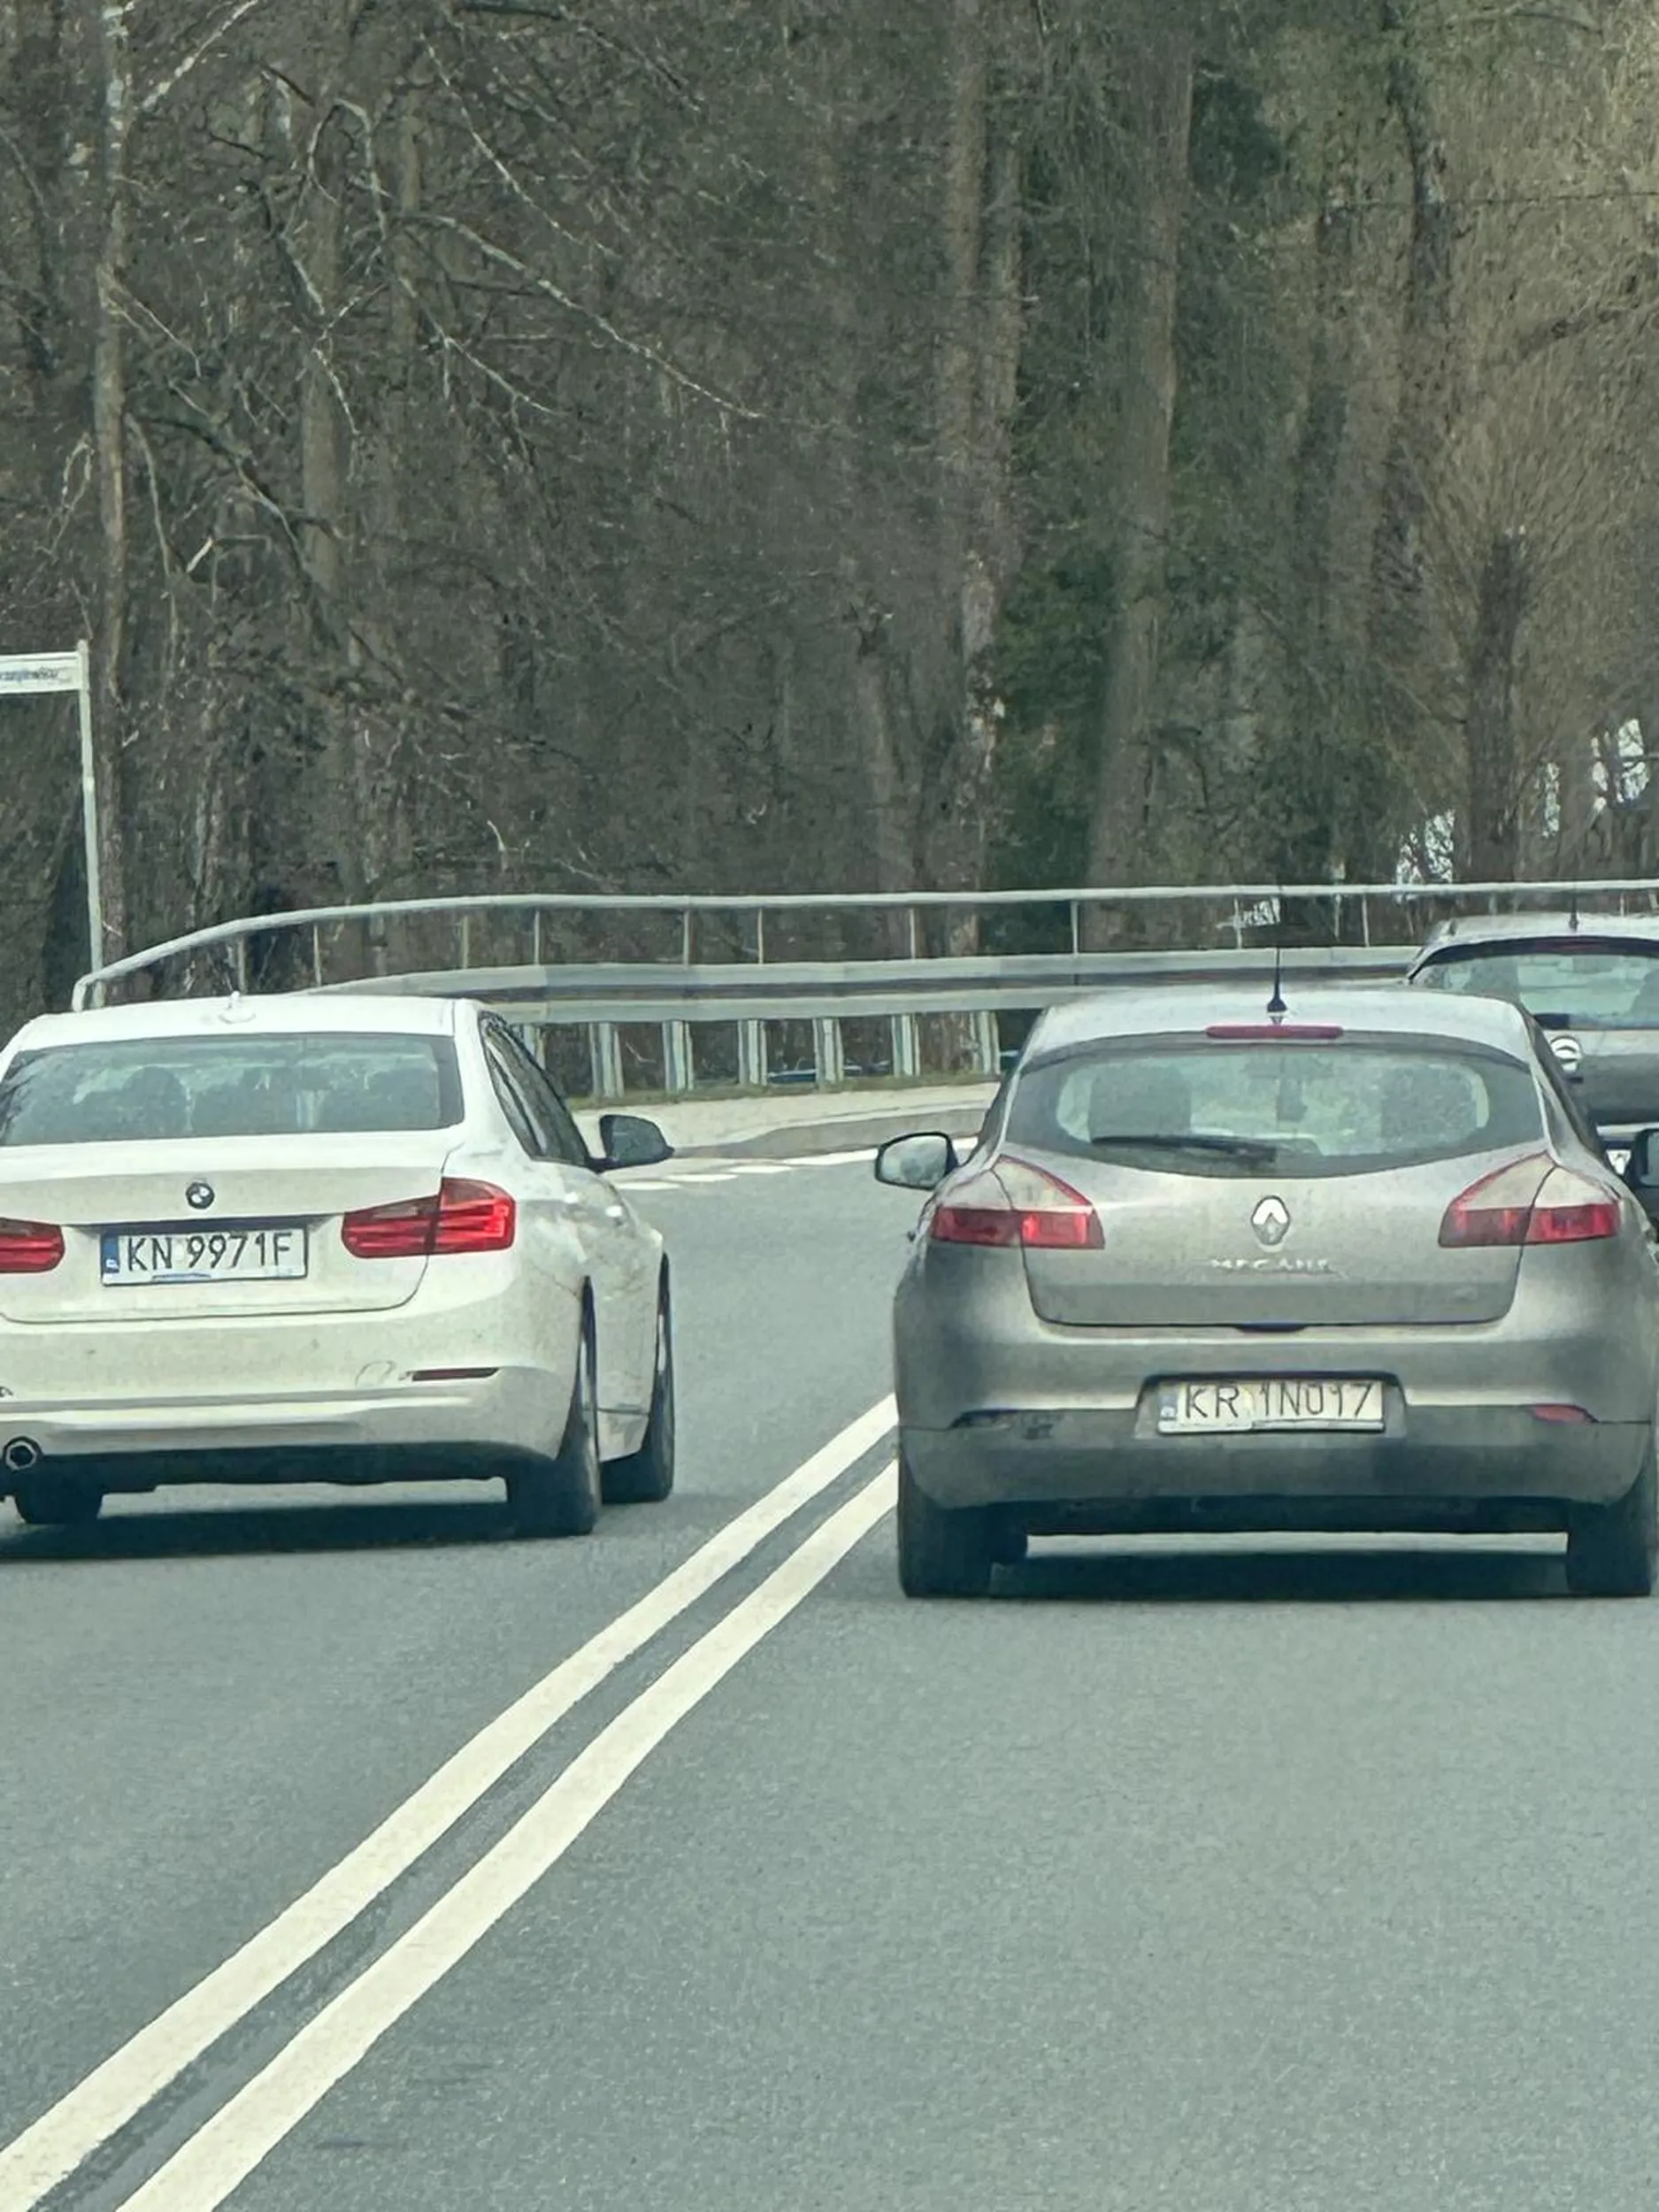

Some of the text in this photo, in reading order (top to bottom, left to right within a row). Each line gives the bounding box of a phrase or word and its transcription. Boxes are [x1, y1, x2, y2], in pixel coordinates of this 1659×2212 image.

[128, 1232, 292, 1271] KN 9971F
[1186, 1383, 1240, 1418] KR
